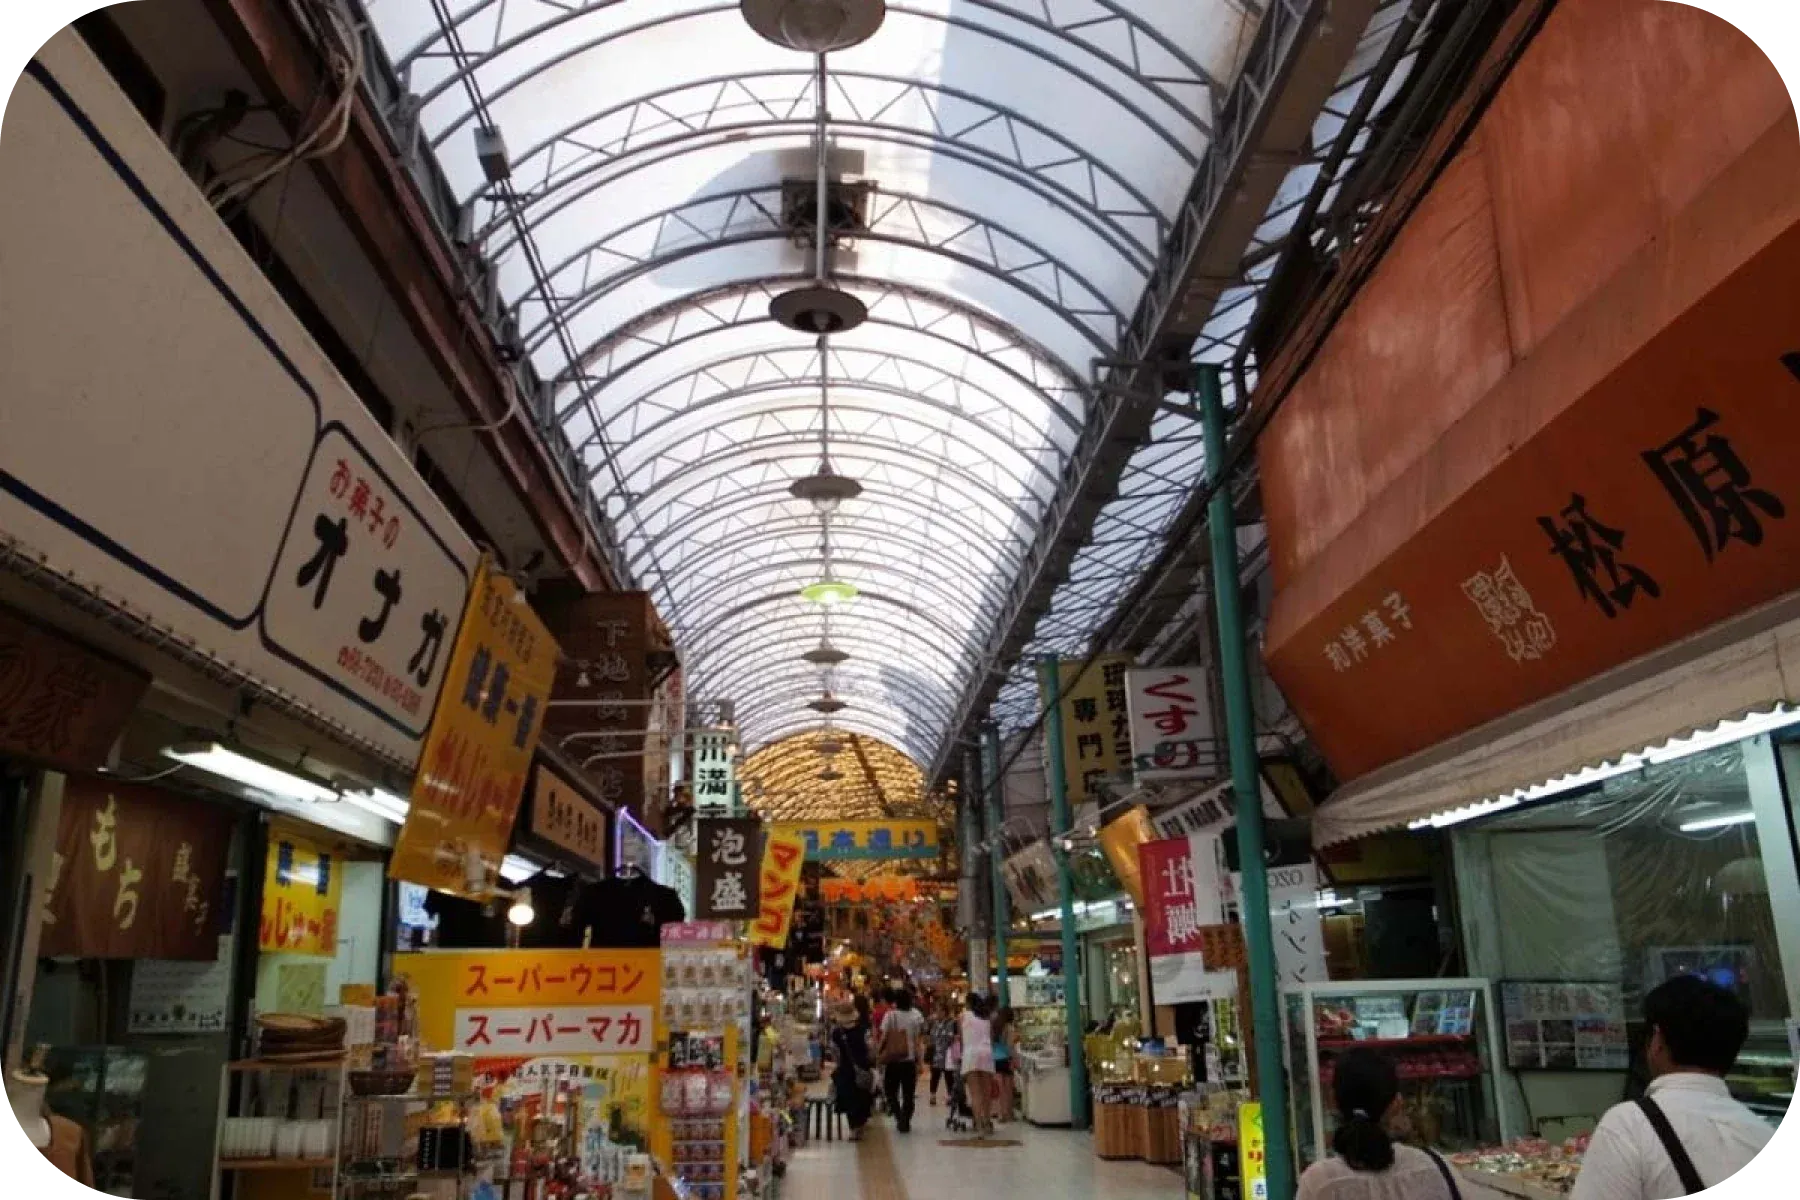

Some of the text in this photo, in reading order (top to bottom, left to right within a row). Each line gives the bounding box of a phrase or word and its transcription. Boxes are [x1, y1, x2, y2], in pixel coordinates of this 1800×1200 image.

[329, 458, 400, 550] お菓子の
[1537, 352, 1800, 618] 松原
[296, 513, 449, 689] オナガ
[1322, 591, 1413, 672] 和洋菓子
[710, 827, 747, 911] 泡盛
[465, 962, 645, 995] スーパーウコン
[464, 1010, 642, 1047] スーパーマカ
